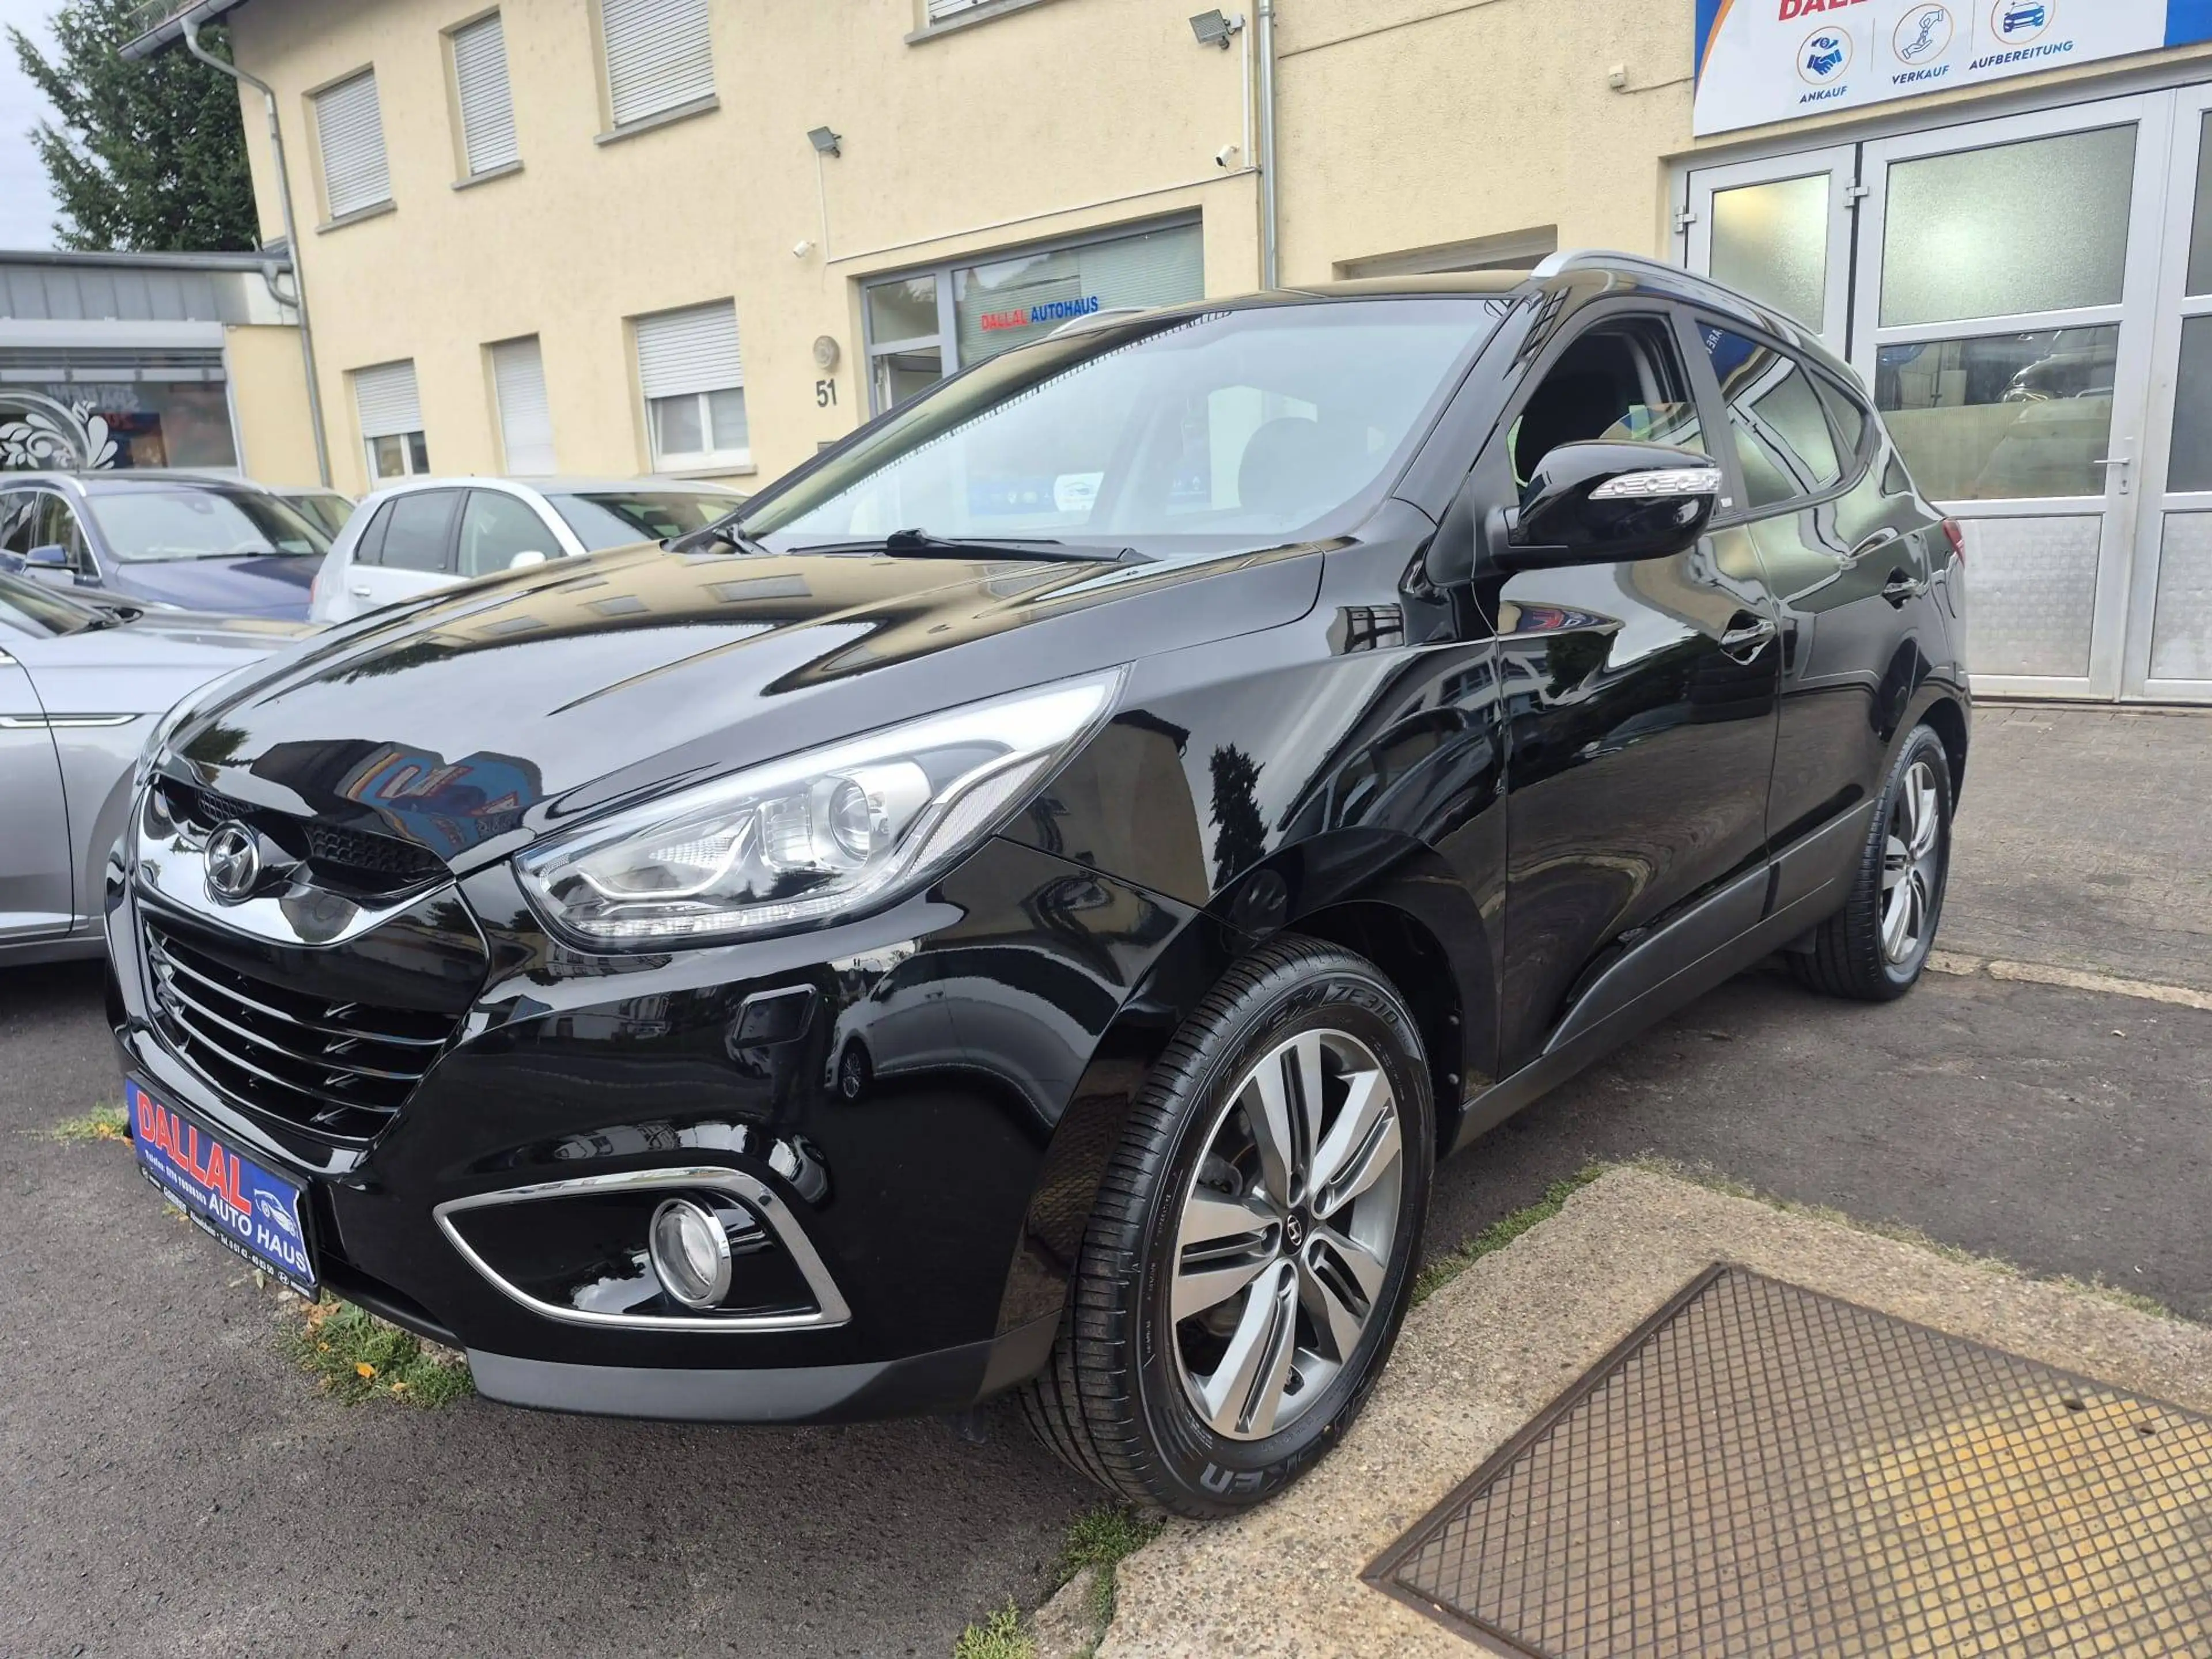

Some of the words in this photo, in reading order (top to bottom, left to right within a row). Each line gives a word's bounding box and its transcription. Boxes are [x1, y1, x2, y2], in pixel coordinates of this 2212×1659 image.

[1969, 40, 2074, 70] AUFBEREITUNG
[1892, 65, 1949, 85] VERKAUF
[1800, 86, 1847, 104] ANKAUF
[982, 309, 1028, 331] DALLAL
[1031, 296, 1099, 323] AUTOHAUS
[816, 378, 836, 408] 51
[137, 1089, 252, 1217] DALLAL
[209, 1193, 252, 1237] AUTO
[257, 1224, 307, 1273] HAUS
